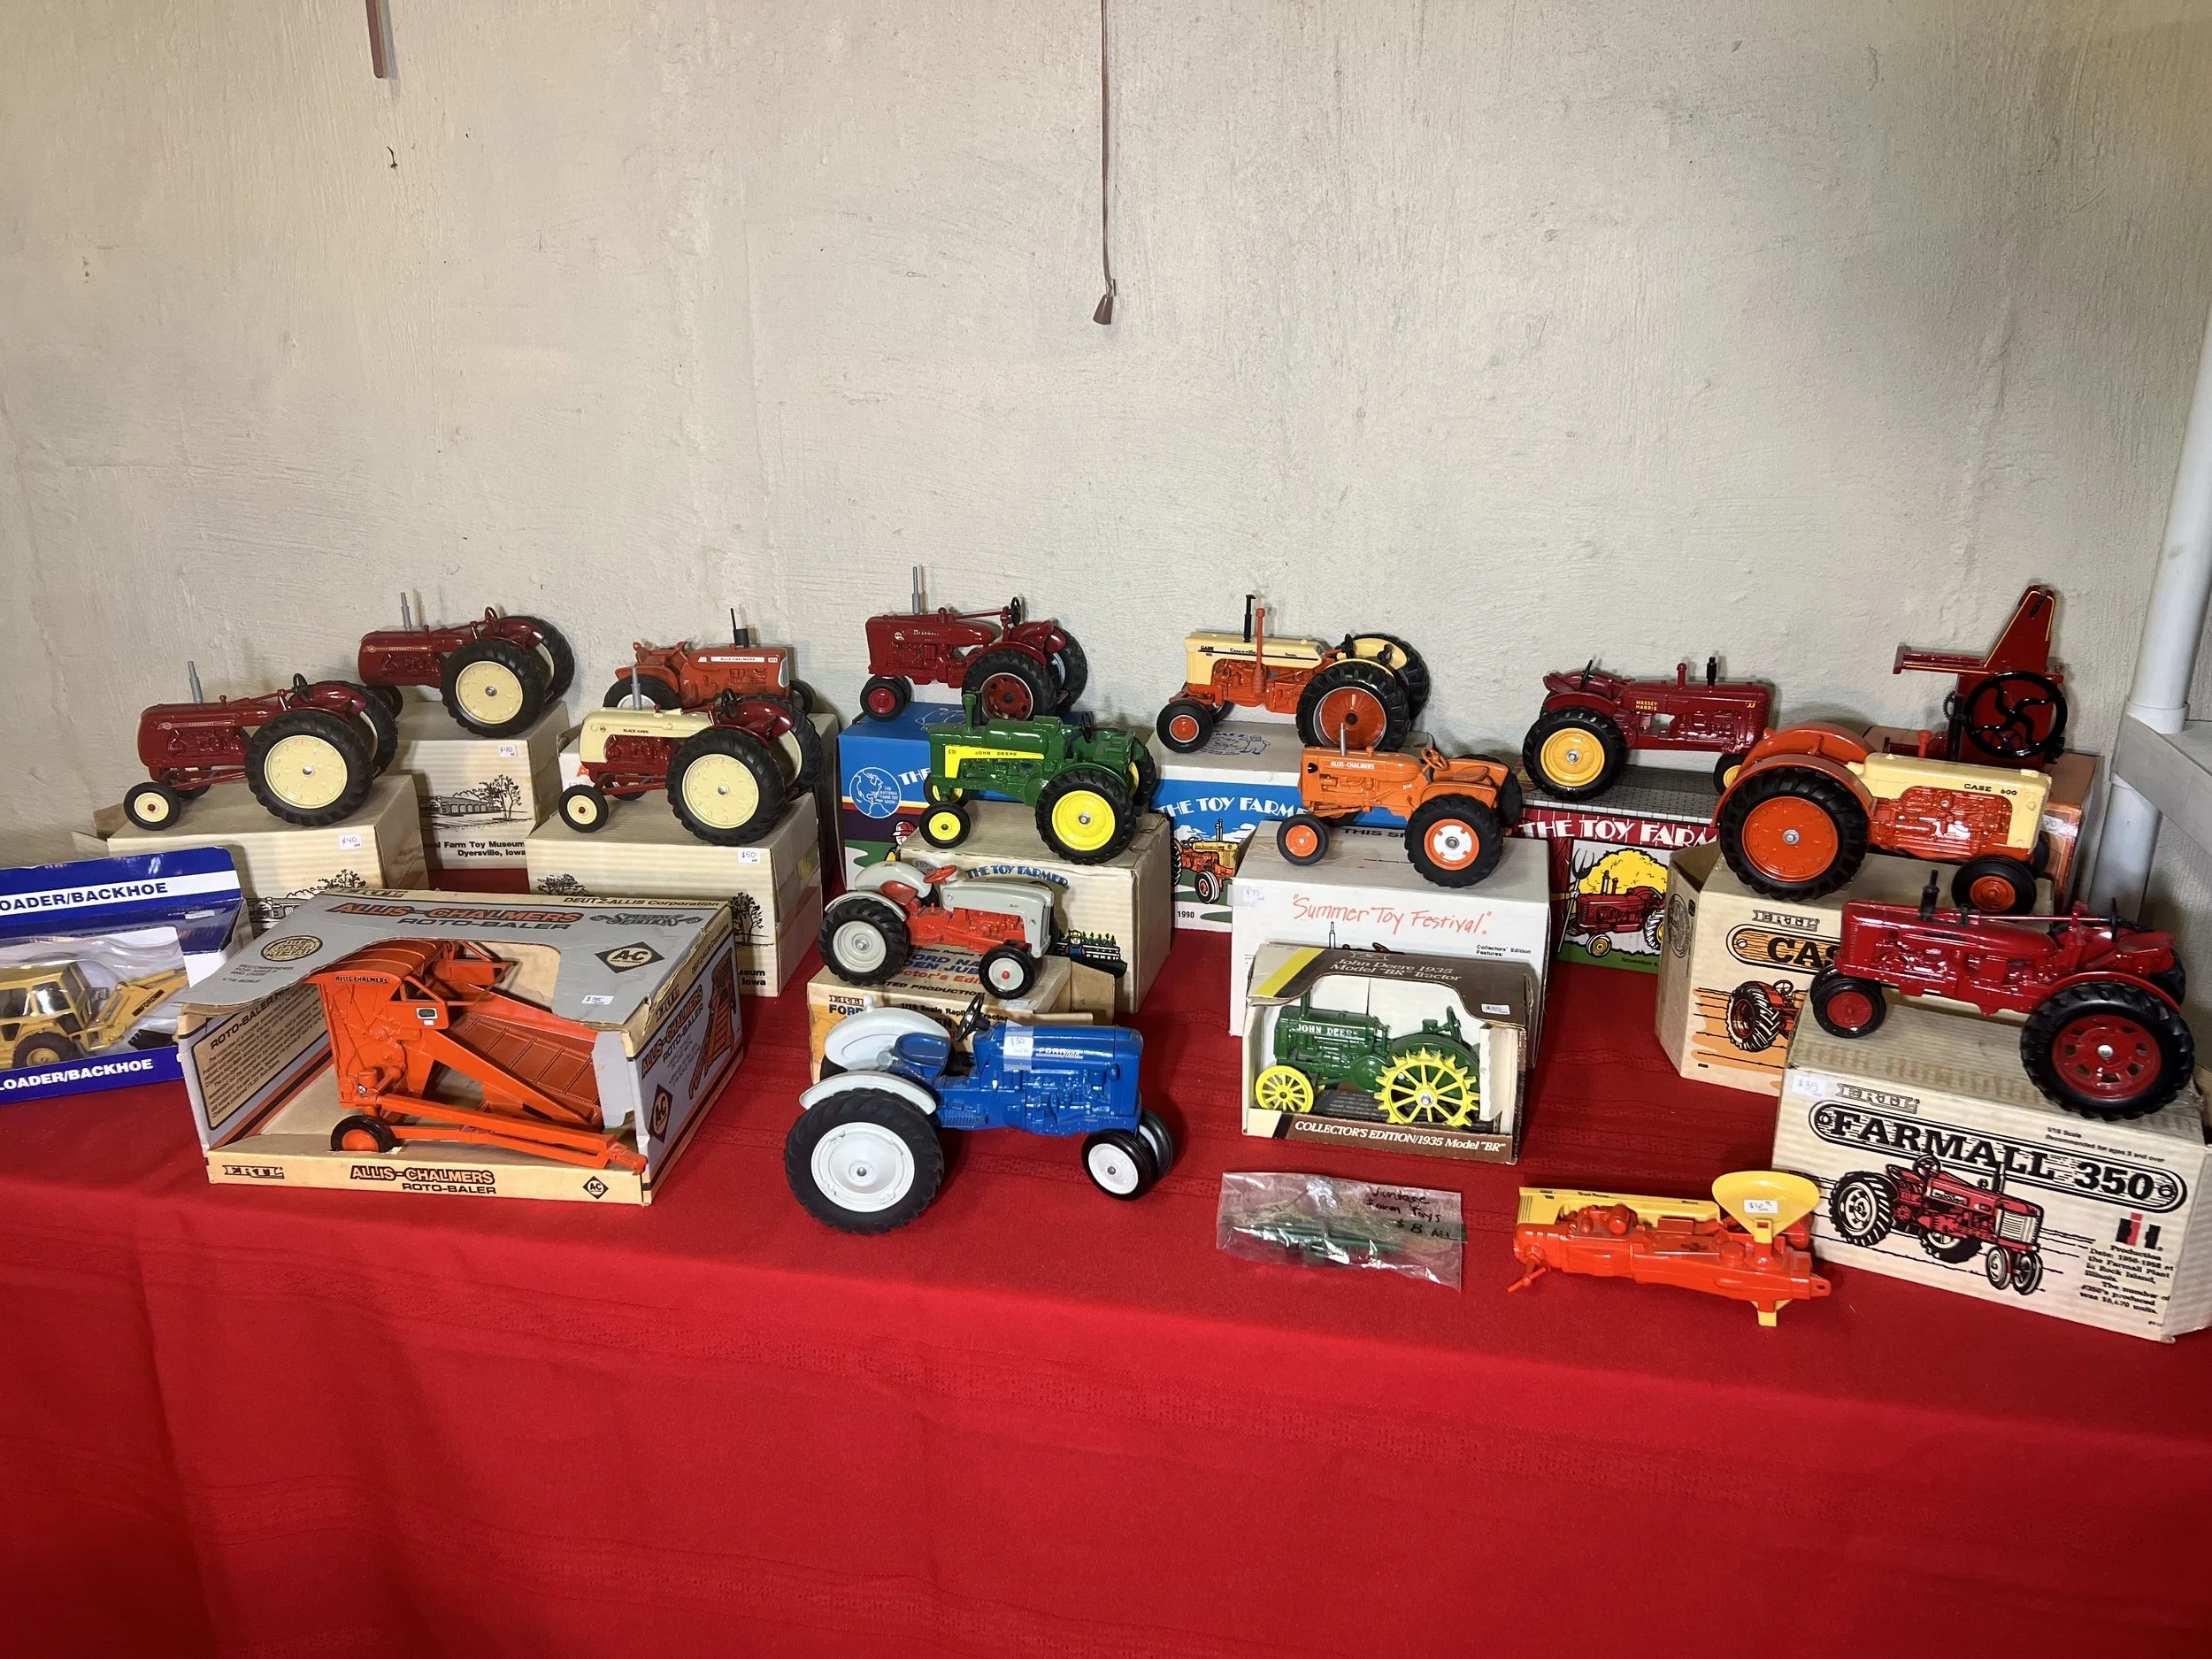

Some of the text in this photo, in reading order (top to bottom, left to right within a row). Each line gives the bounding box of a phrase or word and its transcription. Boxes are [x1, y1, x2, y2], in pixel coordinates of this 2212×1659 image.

[1330, 760, 1375, 770] ALLIS-CHALMERS
[1963, 783, 2018, 796] CASE 600
[1196, 796, 1235, 812] TOY
[1518, 819, 1574, 839] THE
[1579, 819, 1636, 841] TOY
[469, 841, 487, 849] Toy
[964, 864, 1070, 887] THE TOY FARMER
[0, 882, 168, 911] OADER/BACKHOE
[564, 896, 719, 908] DEUTZ-ALLIS Corporation
[326, 902, 584, 924] ALLIS-CHALMERS
[1371, 907, 1404, 935] Toy
[1753, 910, 1820, 931] ERTL
[397, 918, 572, 931] ROTO-BALER
[910, 953, 951, 964] ORD
[1334, 958, 1454, 974] John Deere 1935
[1329, 963, 1375, 974] Model
[1414, 970, 1463, 981] Tractor
[741, 977, 766, 986] Iowa
[920, 1004, 943, 1014] Scale
[211, 999, 275, 1050] ROTO-BALER
[1296, 1023, 1322, 1034] JOHN
[1837, 1083, 1919, 1115] ERTL
[1294, 1120, 1369, 1139] COLLECTOR'S
[1369, 1128, 1444, 1146] EDITION/1935
[1444, 1138, 1480, 1150] Model
[2045, 1133, 2096, 1149] Recommended
[2133, 1151, 2147, 1160] and
[1830, 1110, 2155, 1201] FARMALL 350
[223, 1164, 285, 1179] ERTL
[349, 1164, 495, 1186] ALLIS-CHALMERS
[402, 1182, 497, 1195] ROTO-BALER
[2109, 1244, 2162, 1262] Production
[2087, 1256, 2170, 1279] the Farmall Plant
[2099, 1265, 2123, 1276] Rock
[2079, 1292, 2099, 1301] was
[2101, 1280, 2119, 1291] The
[2122, 1286, 2159, 1300] number
[2111, 1292, 2156, 1307] produced
